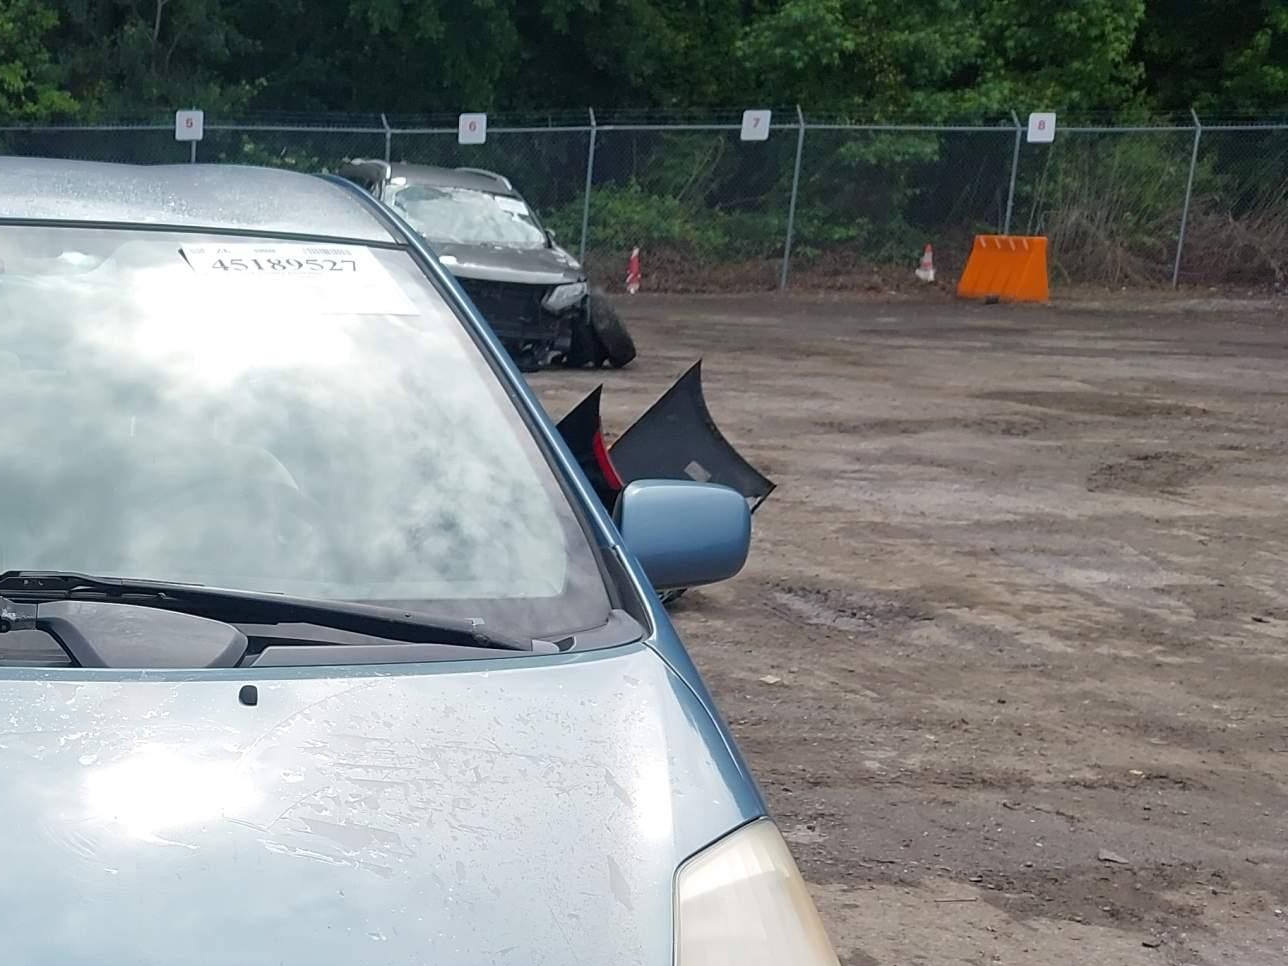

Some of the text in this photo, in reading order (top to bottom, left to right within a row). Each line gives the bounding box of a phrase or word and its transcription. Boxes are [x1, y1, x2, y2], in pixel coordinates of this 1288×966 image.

[185, 118, 194, 129] 5
[468, 120, 476, 132] 6
[753, 117, 762, 128] 7
[211, 258, 357, 272] 45189527
